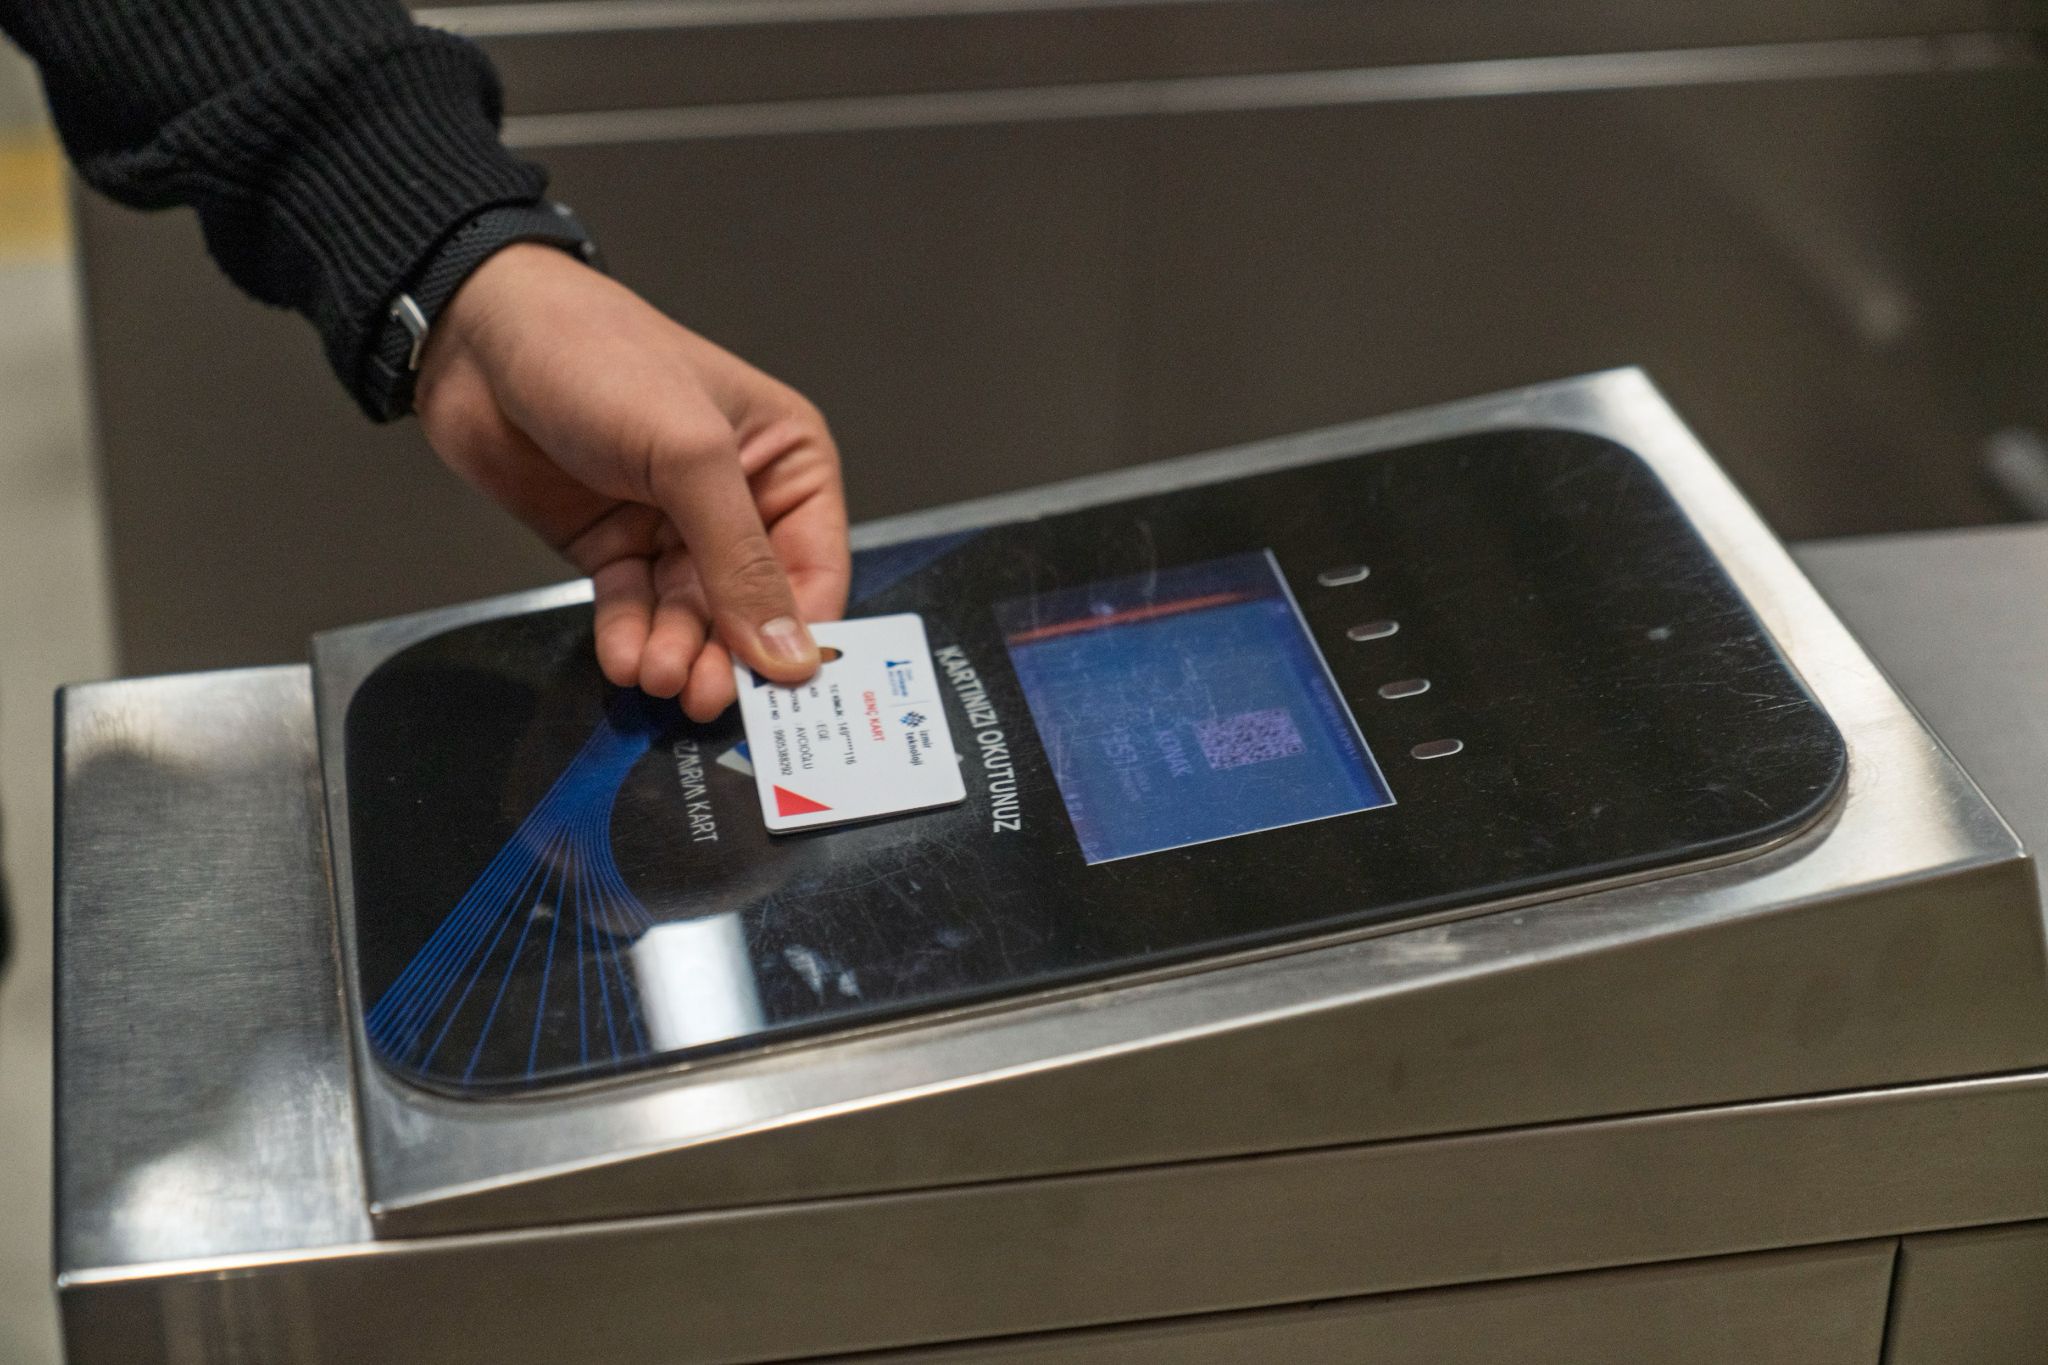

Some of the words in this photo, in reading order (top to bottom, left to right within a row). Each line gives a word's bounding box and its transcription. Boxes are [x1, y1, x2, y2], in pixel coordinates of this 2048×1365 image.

[863, 690, 878, 717] GENÇ
[869, 717, 885, 742] KART
[918, 729, 933, 749] izmir
[934, 645, 998, 728] KARTINIZI
[976, 729, 1021, 833] OKUTUNUZ
[903, 731, 922, 766] teknoloji
[686, 801, 718, 841] KART
